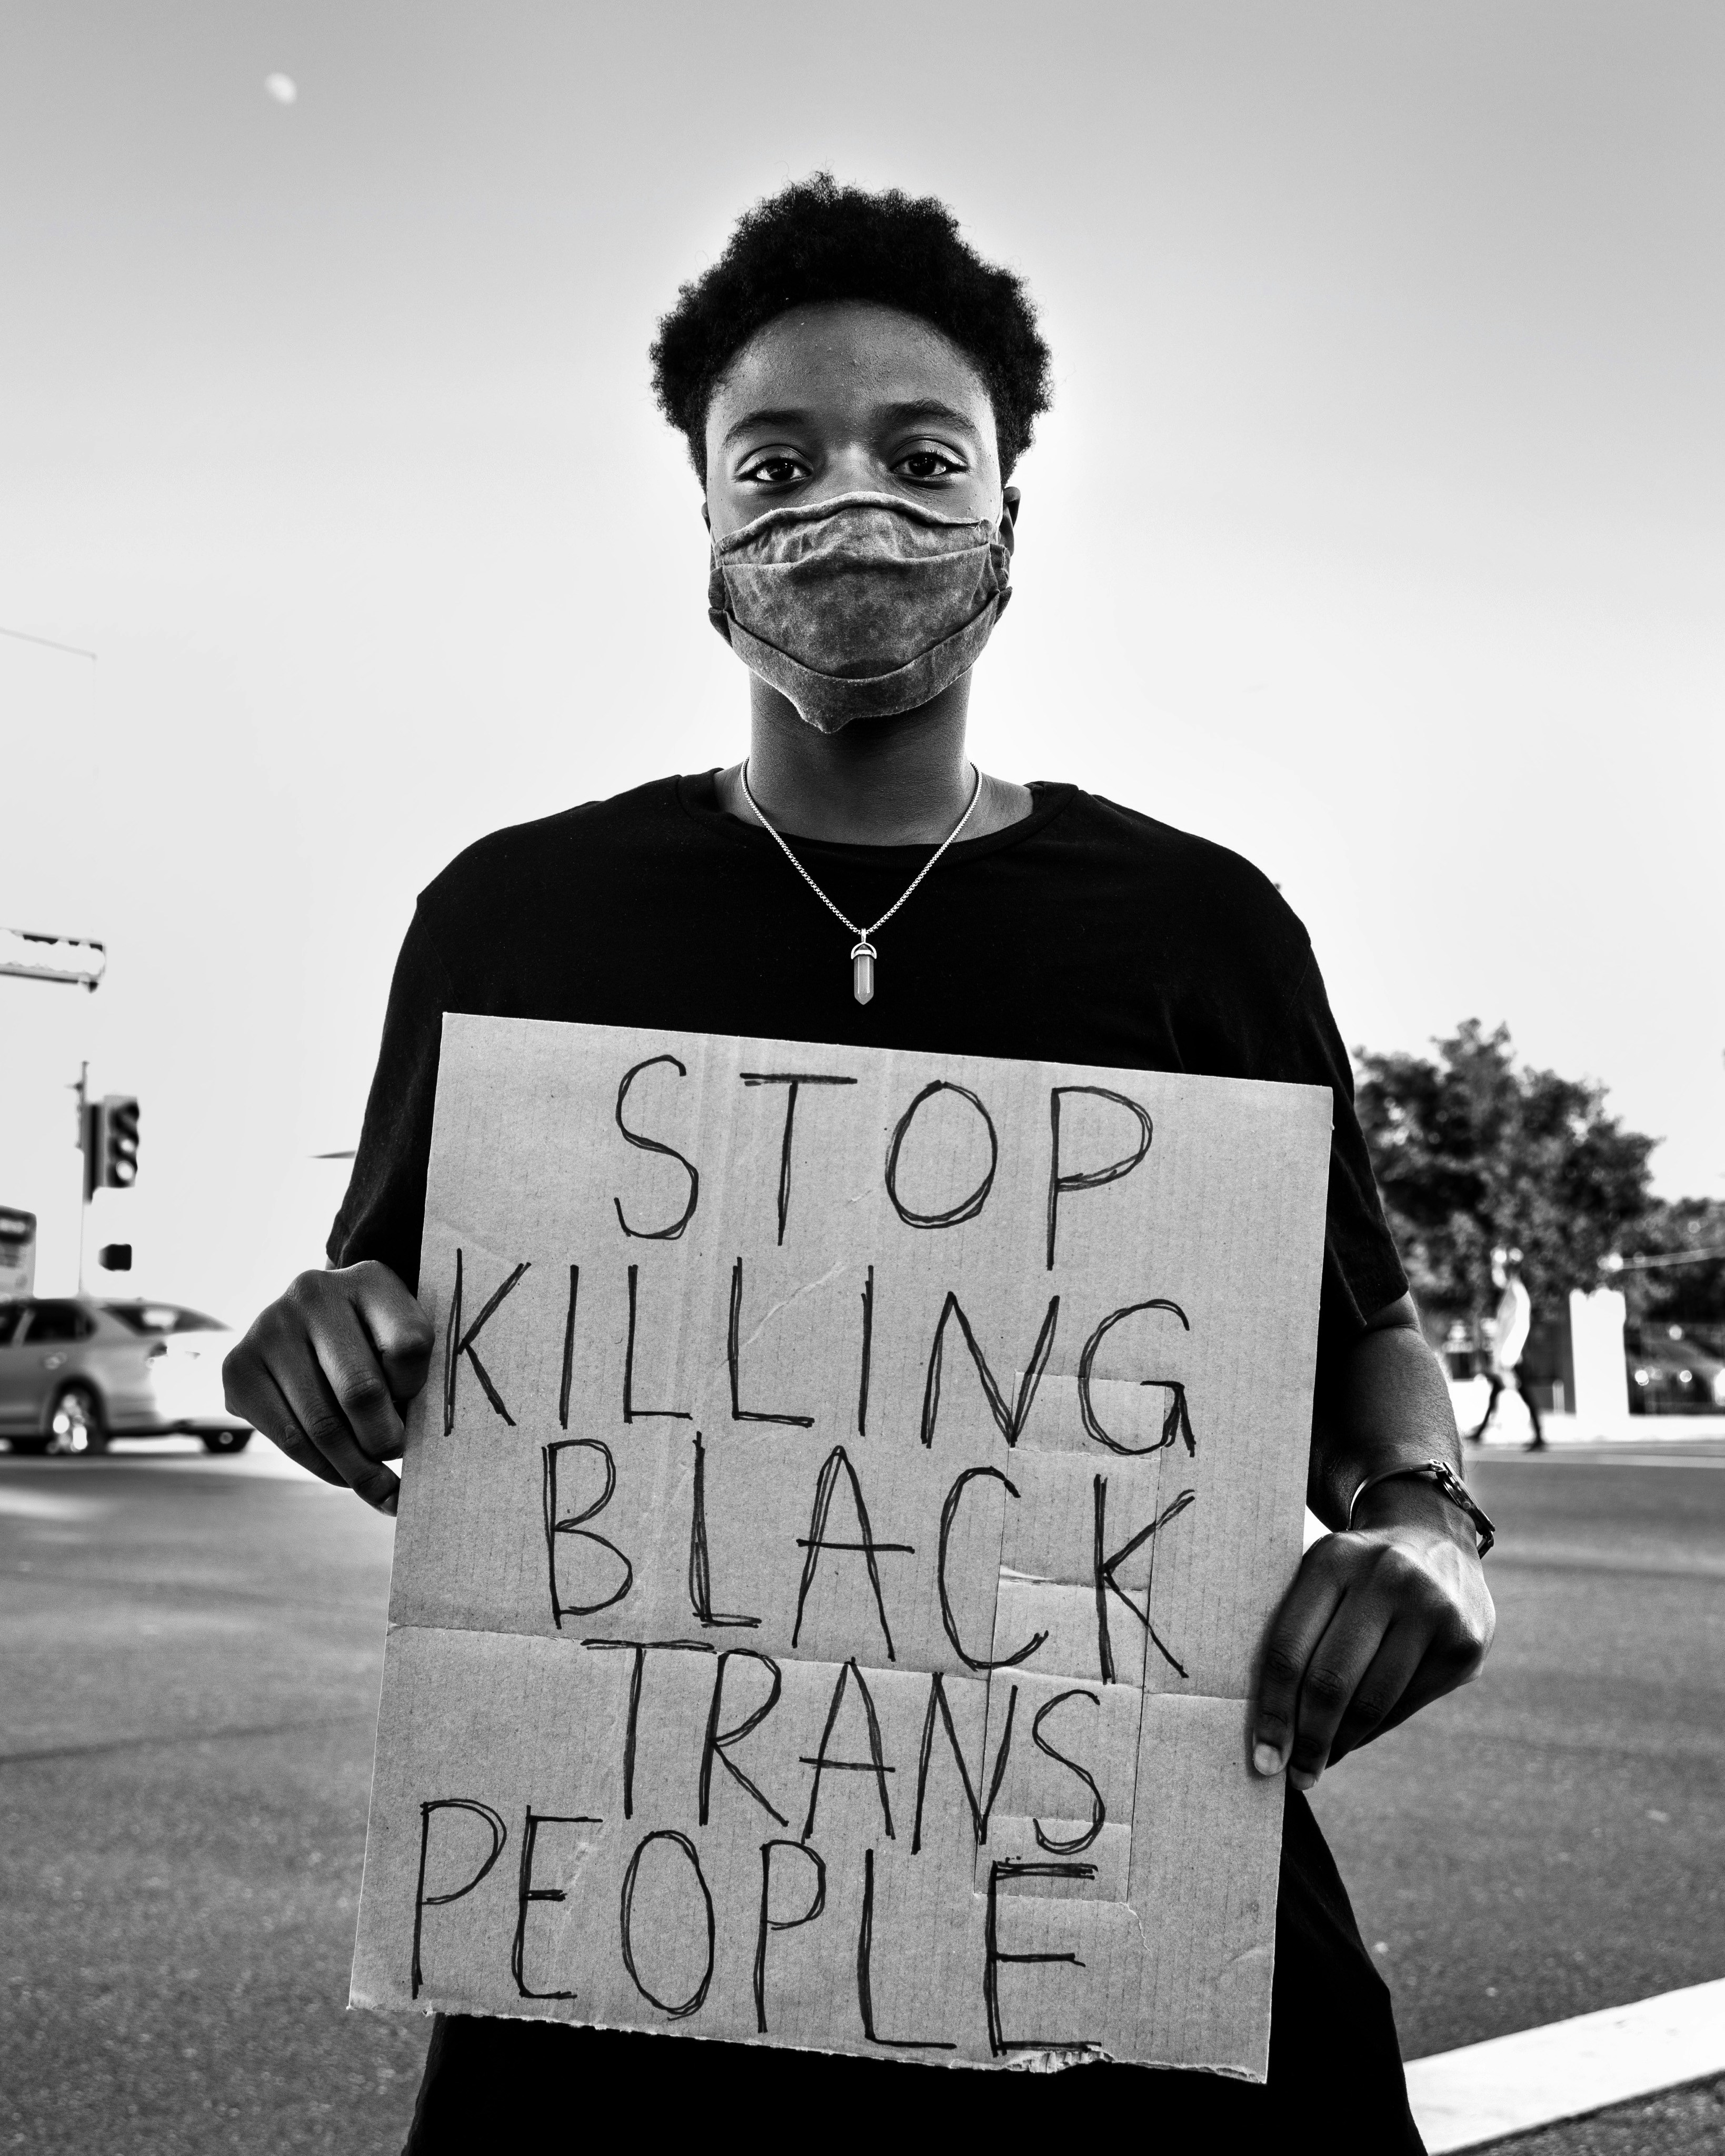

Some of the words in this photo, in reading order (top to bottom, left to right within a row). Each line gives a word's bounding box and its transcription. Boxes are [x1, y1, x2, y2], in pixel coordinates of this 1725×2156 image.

[614, 1055, 1152, 1270] STOP
[444, 1250, 1195, 1456] KILLING
[543, 1432, 1195, 1684] BLACK
[581, 1640, 1106, 1855] TRANS
[411, 1799, 1102, 2056] PEOPLE
